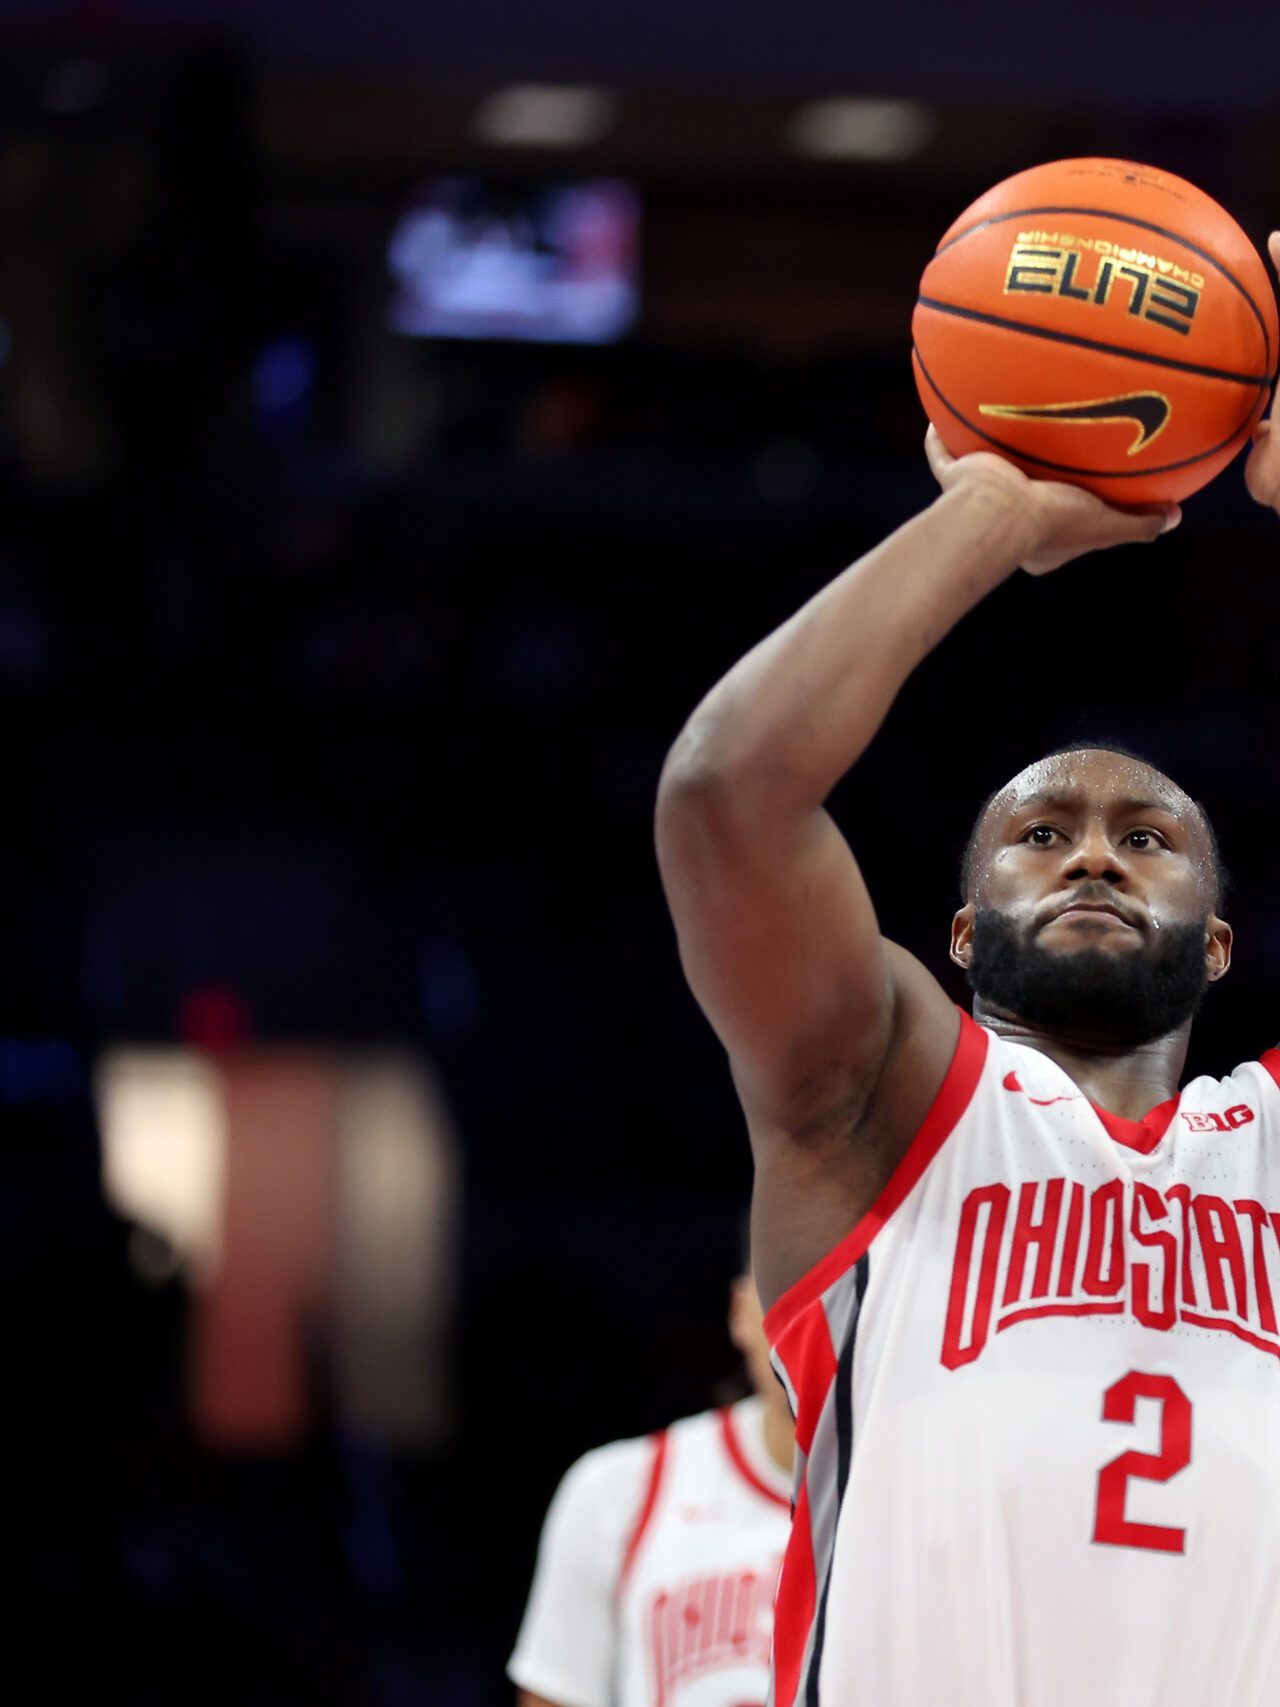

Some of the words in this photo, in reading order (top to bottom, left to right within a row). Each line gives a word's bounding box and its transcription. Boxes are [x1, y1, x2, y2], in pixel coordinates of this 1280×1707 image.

[1004, 243, 1201, 336] ELITE
[1016, 231, 1205, 289] CHAMPIONSHIP
[940, 1177, 1126, 1371] OHIO
[1090, 1370, 1192, 1556] 2
